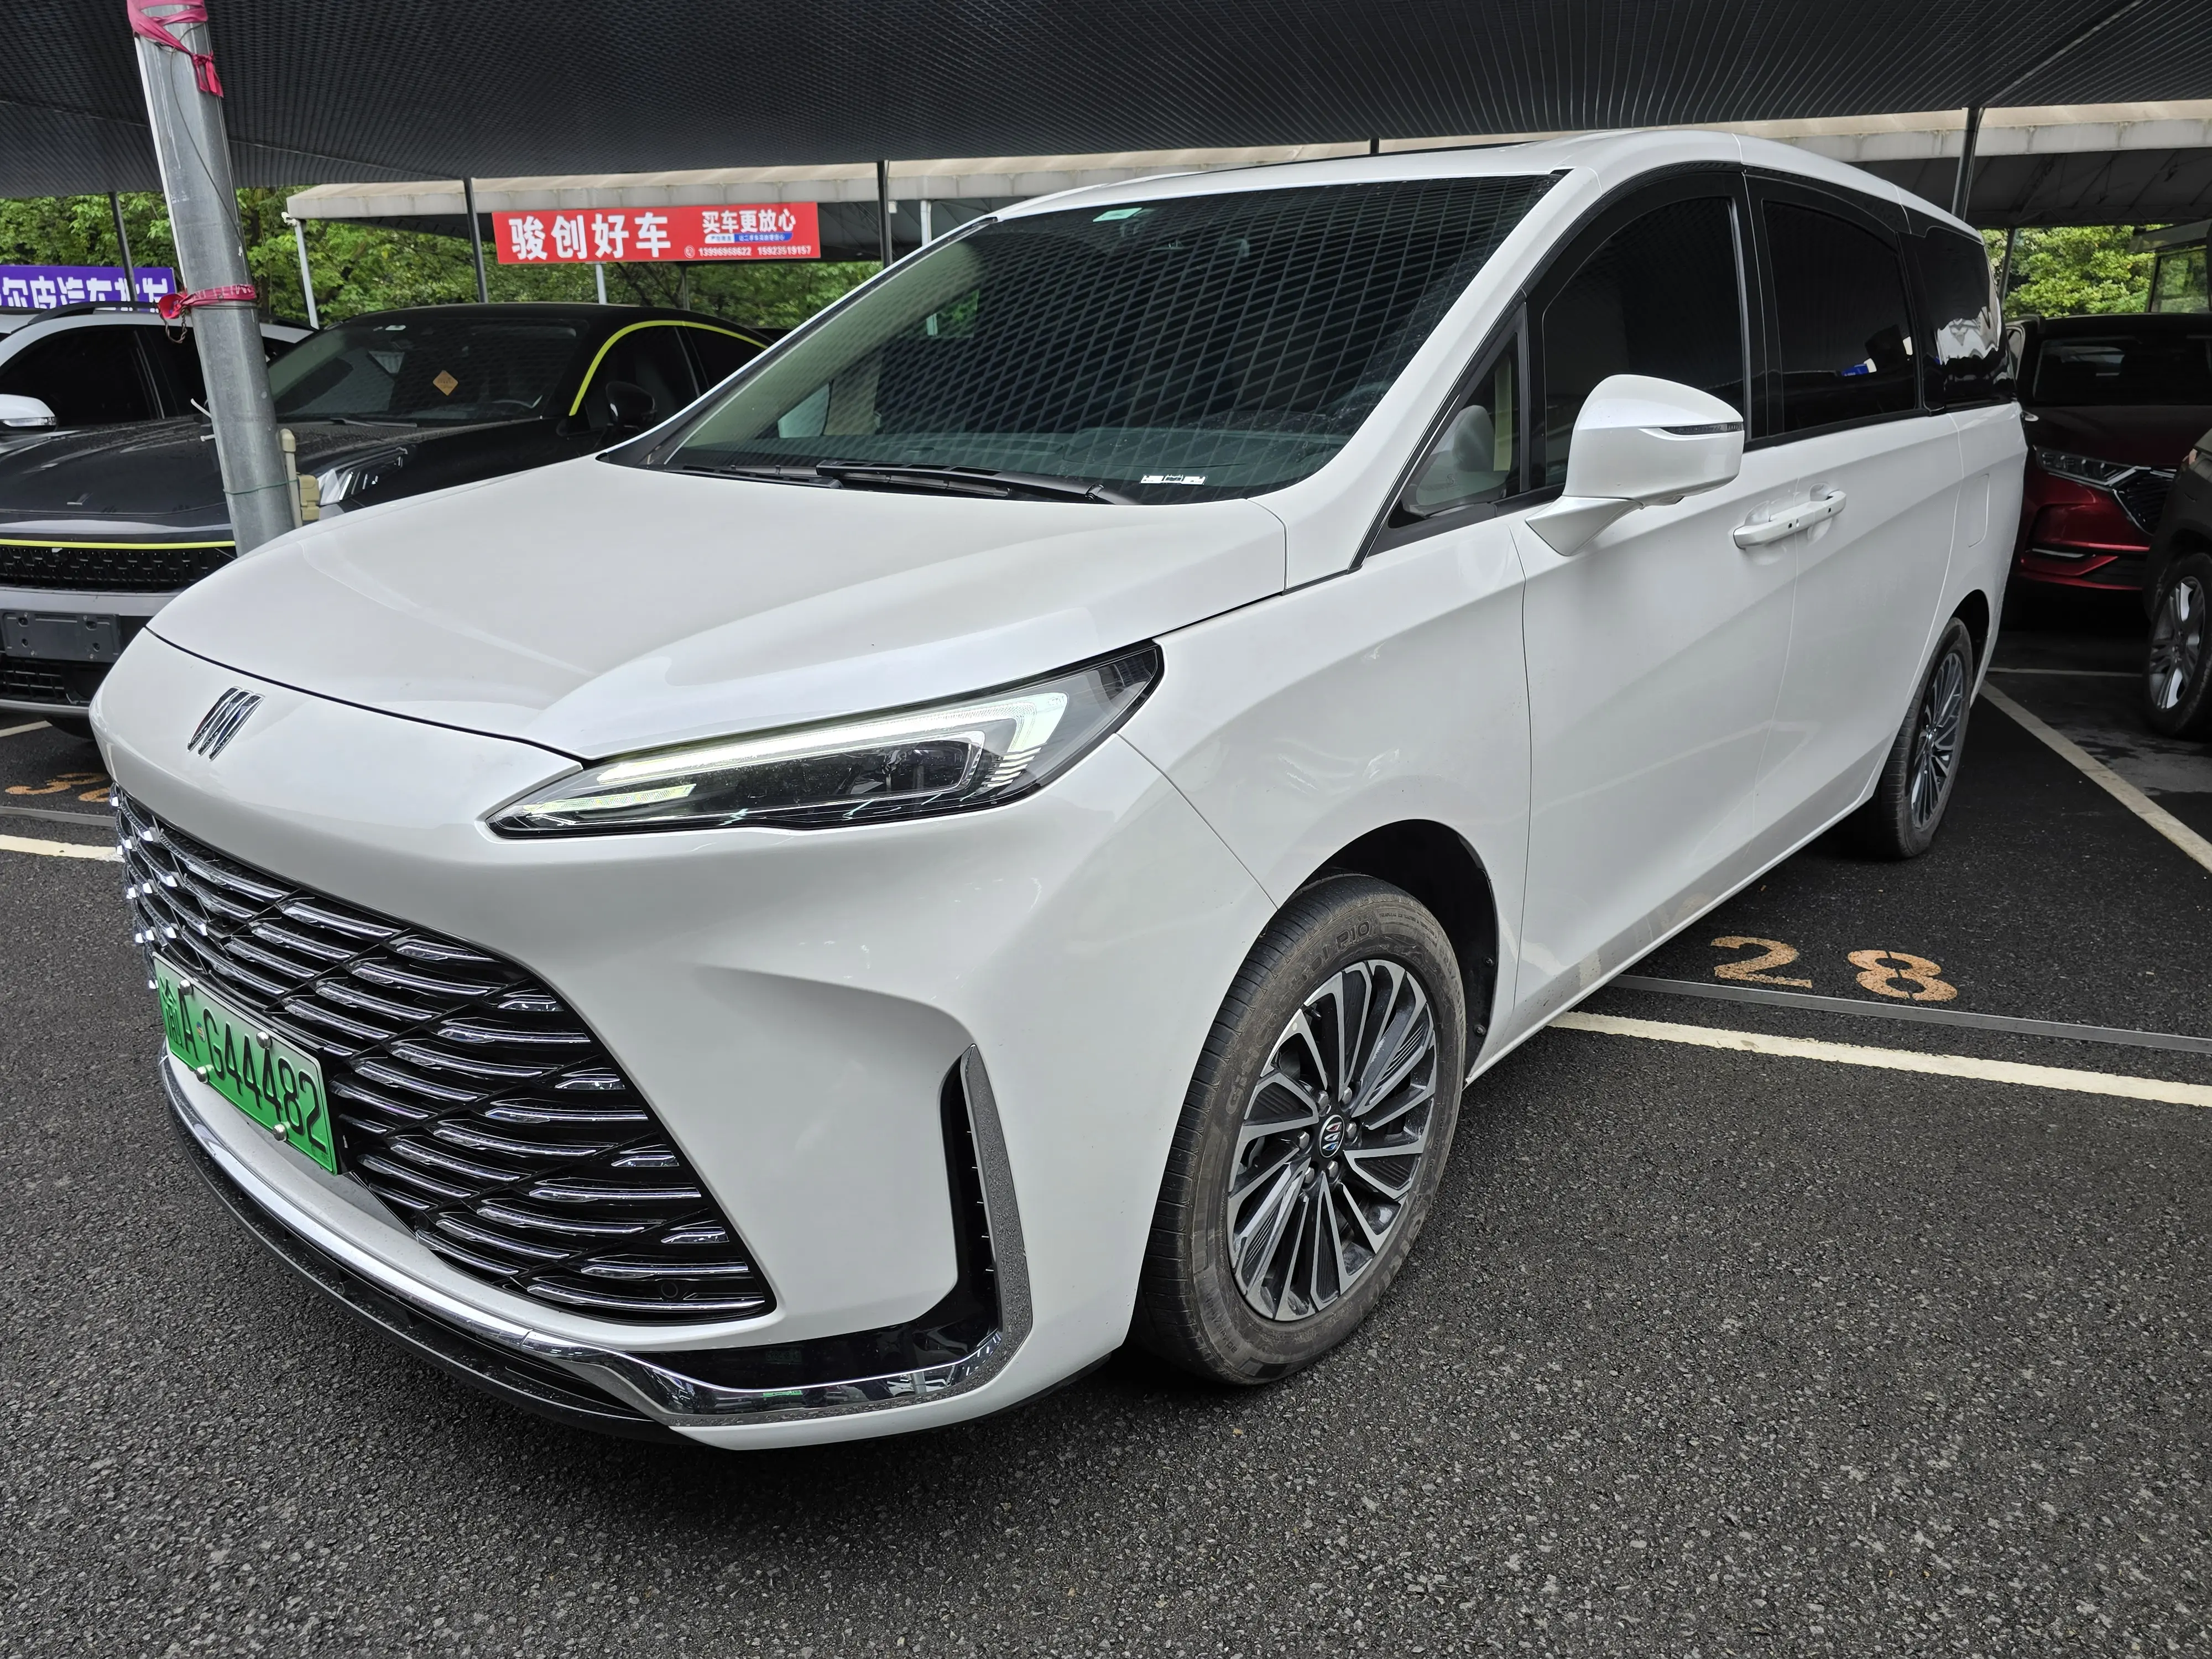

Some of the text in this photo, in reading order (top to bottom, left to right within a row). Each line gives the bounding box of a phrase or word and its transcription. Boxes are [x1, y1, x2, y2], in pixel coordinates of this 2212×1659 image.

[508, 212, 671, 260] 骏创好车
[702, 208, 796, 233] 买车更放心
